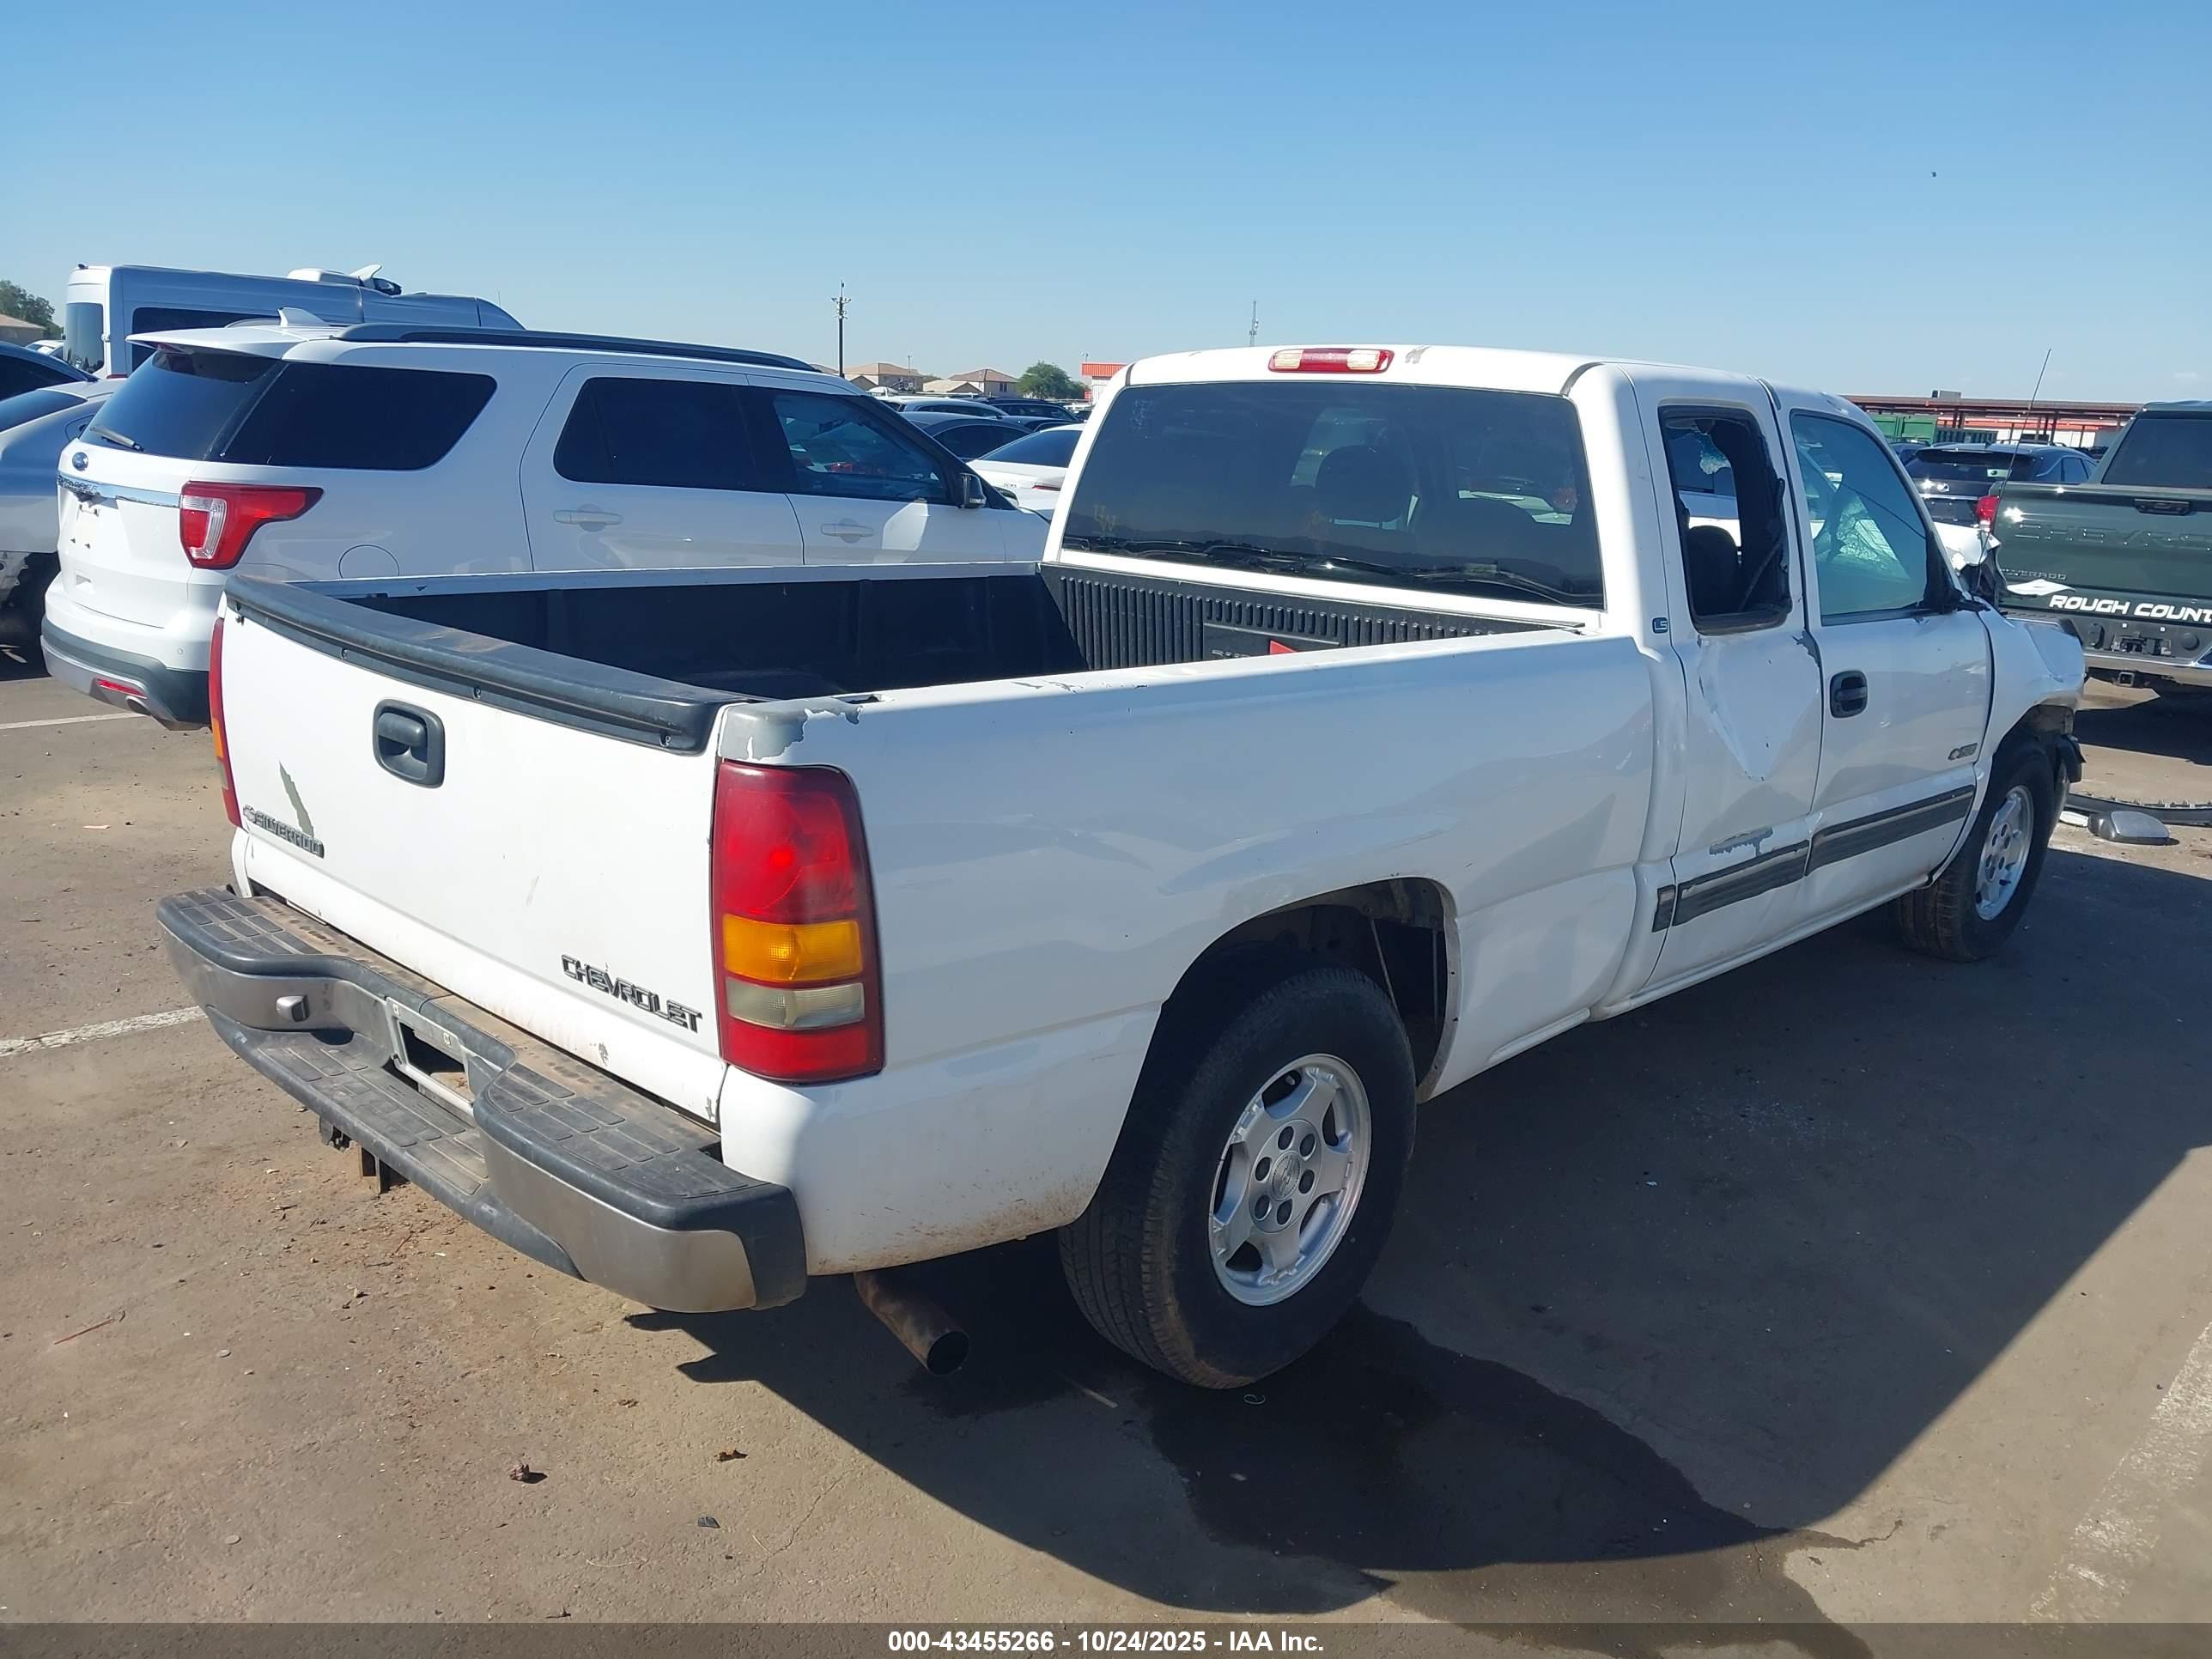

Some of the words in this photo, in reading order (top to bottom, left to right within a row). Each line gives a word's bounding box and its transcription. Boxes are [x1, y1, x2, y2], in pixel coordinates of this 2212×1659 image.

[2049, 594, 2130, 615] ROUGH
[2134, 603, 2212, 623] COUNT
[254, 810, 325, 859] SILVERADO
[561, 954, 703, 1034] CHEVROLET
